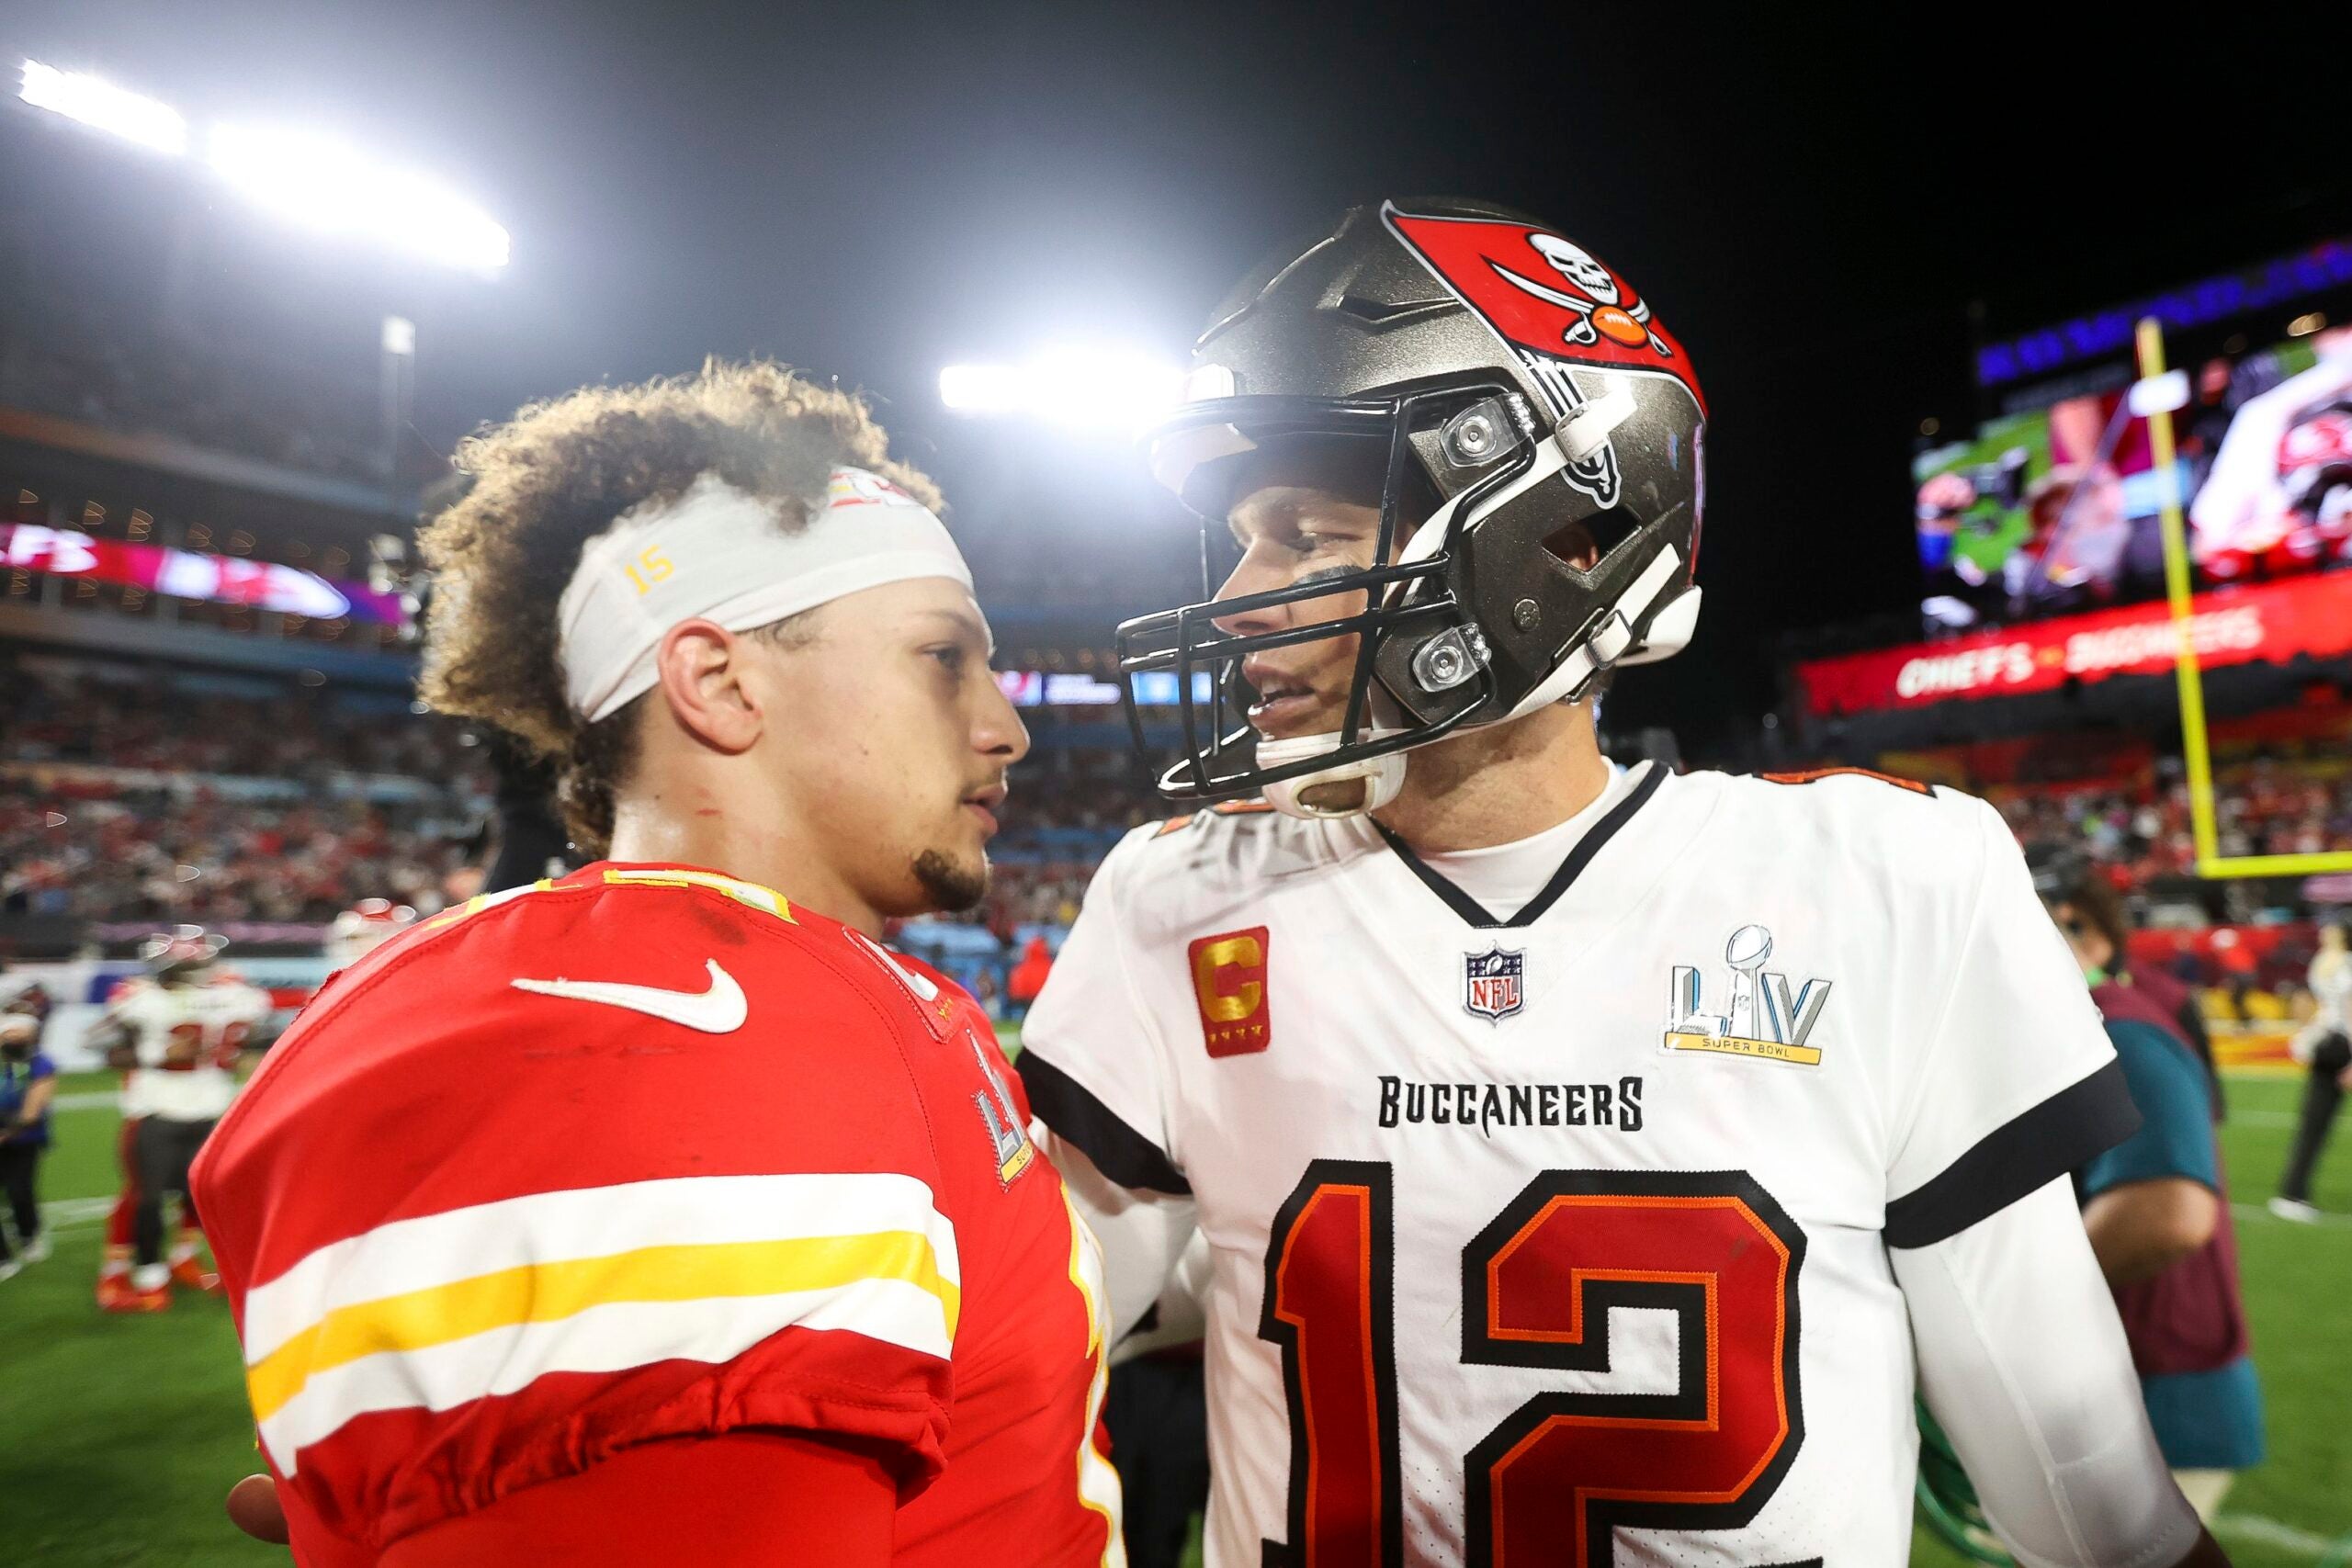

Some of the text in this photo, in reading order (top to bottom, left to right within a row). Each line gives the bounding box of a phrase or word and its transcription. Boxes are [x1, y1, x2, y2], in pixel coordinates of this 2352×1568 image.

[624, 544, 675, 595] 15
[1198, 936, 1261, 1021] C
[1470, 976, 1521, 1012] NFL
[1702, 1037, 1791, 1058] SUPER BOWL
[1377, 1075, 1644, 1137] BUCCANEERS
[1258, 1158, 1823, 1568] 12
